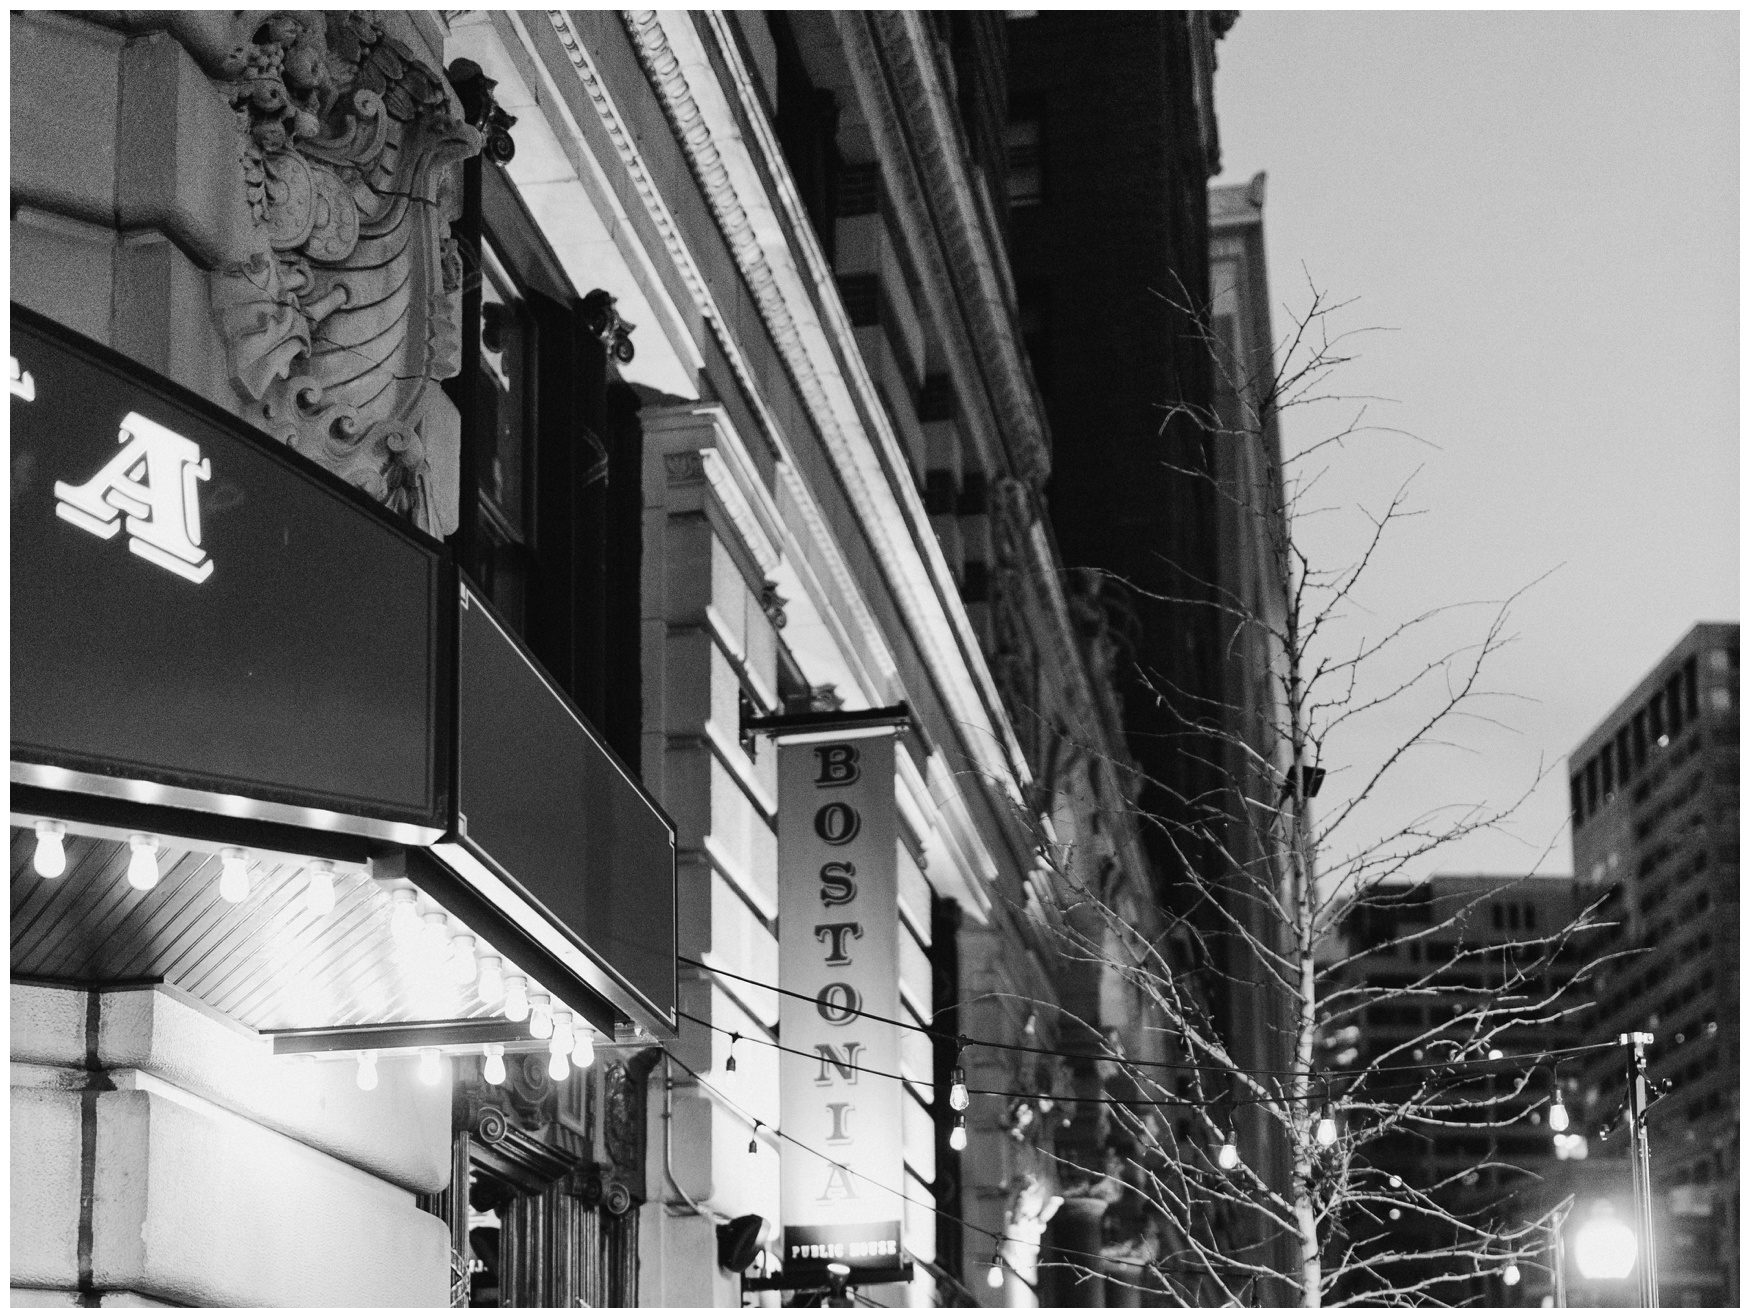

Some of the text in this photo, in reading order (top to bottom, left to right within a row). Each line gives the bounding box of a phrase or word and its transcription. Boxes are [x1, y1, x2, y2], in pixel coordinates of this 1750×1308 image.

[10, 356, 214, 584] A
[813, 743, 866, 1206] BOSTONIA
[791, 1243, 844, 1260] PUBLIC
